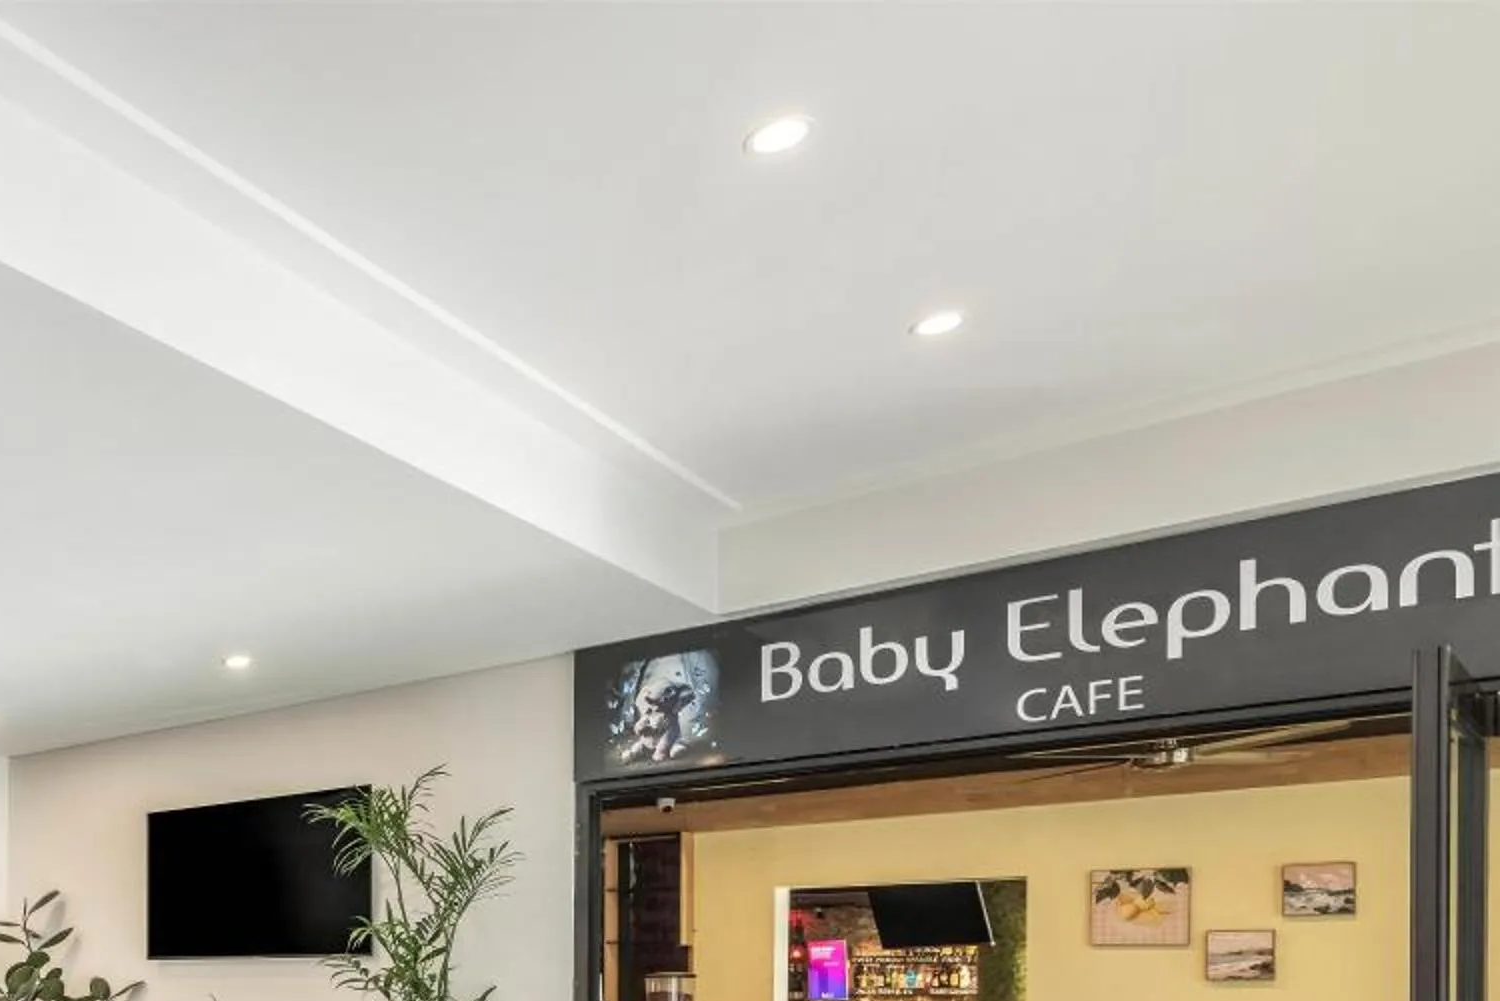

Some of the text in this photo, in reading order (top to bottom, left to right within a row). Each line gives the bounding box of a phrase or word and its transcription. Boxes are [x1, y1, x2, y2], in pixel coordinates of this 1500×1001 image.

[760, 517, 1500, 703] Baby Elephant
[1015, 674, 1146, 723] CAFE
